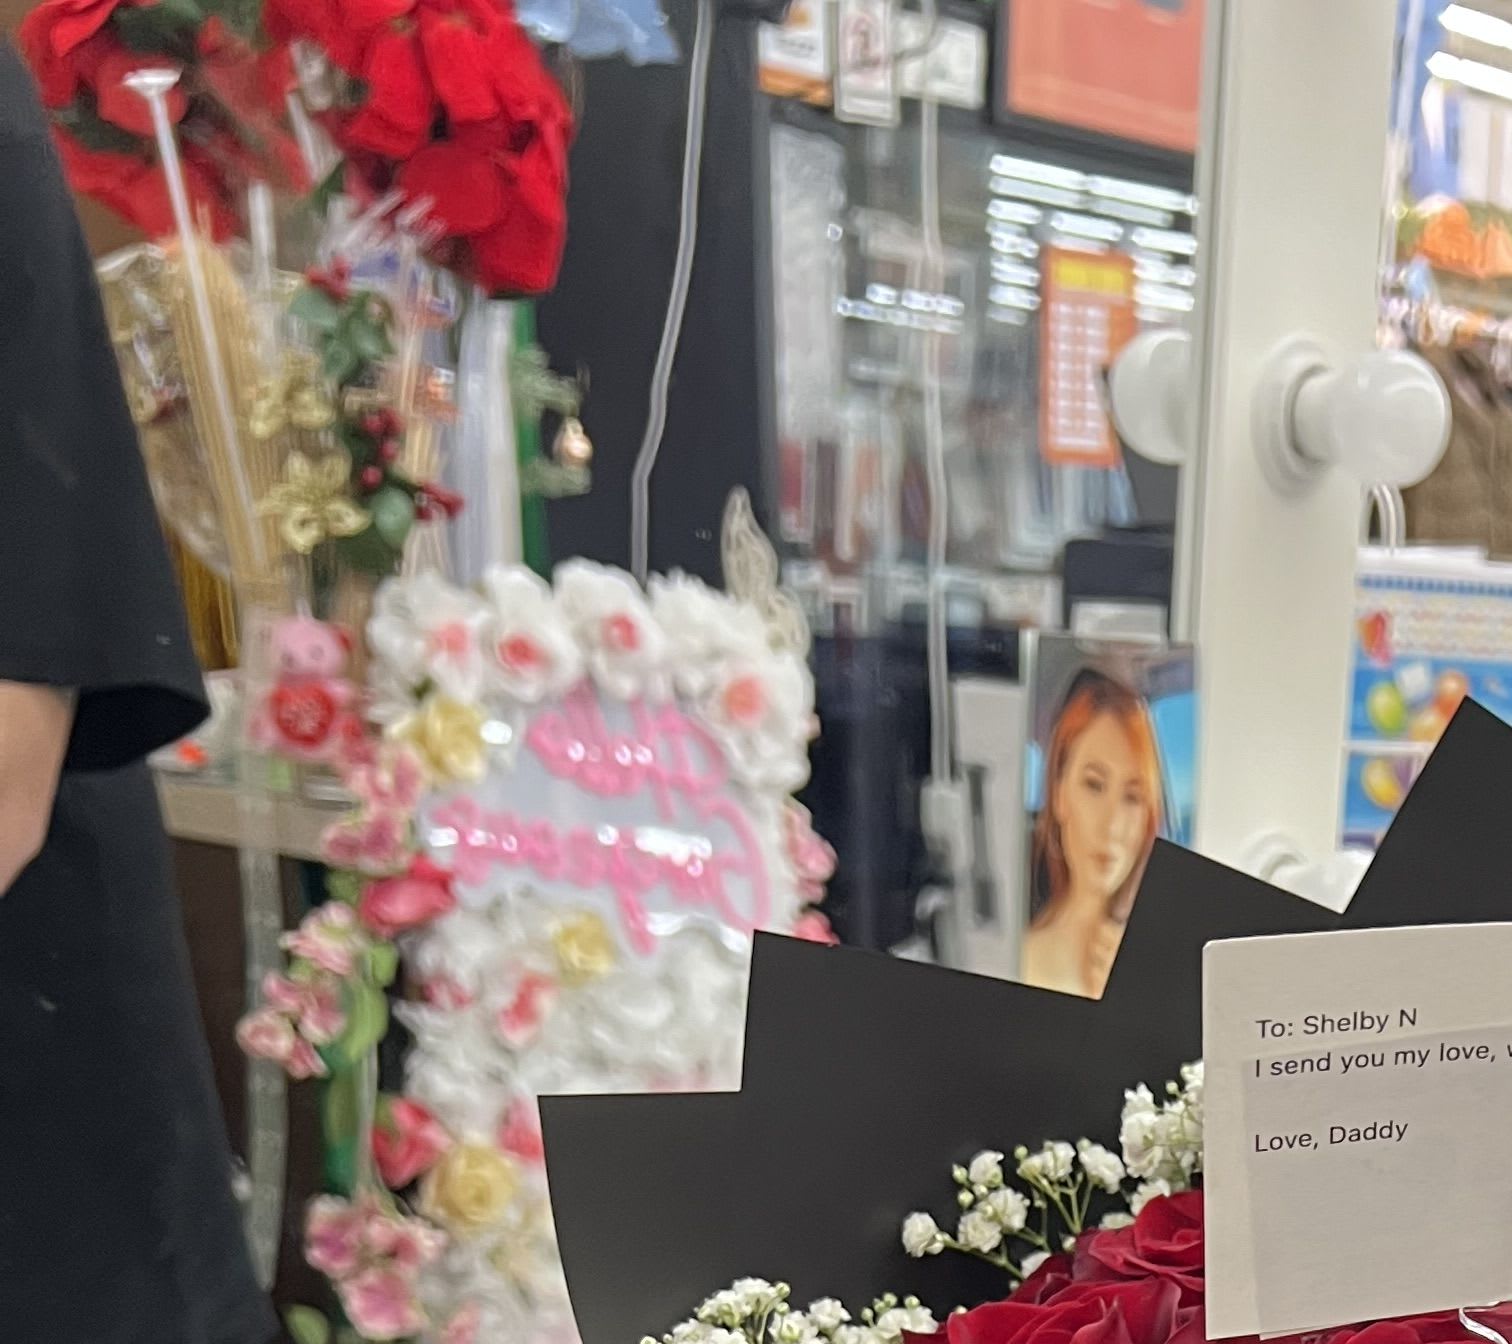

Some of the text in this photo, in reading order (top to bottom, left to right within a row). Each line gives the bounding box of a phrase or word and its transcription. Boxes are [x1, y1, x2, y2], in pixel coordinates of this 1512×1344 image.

[1254, 1007, 1417, 1040] To: Shelby N
[1254, 1058, 1261, 1079] I
[1269, 1058, 1332, 1077] send
[1340, 1051, 1385, 1075] you
[1393, 1048, 1431, 1068] my
[1439, 1042, 1496, 1063] love,
[1254, 1119, 1409, 1153] Love, Daddy
